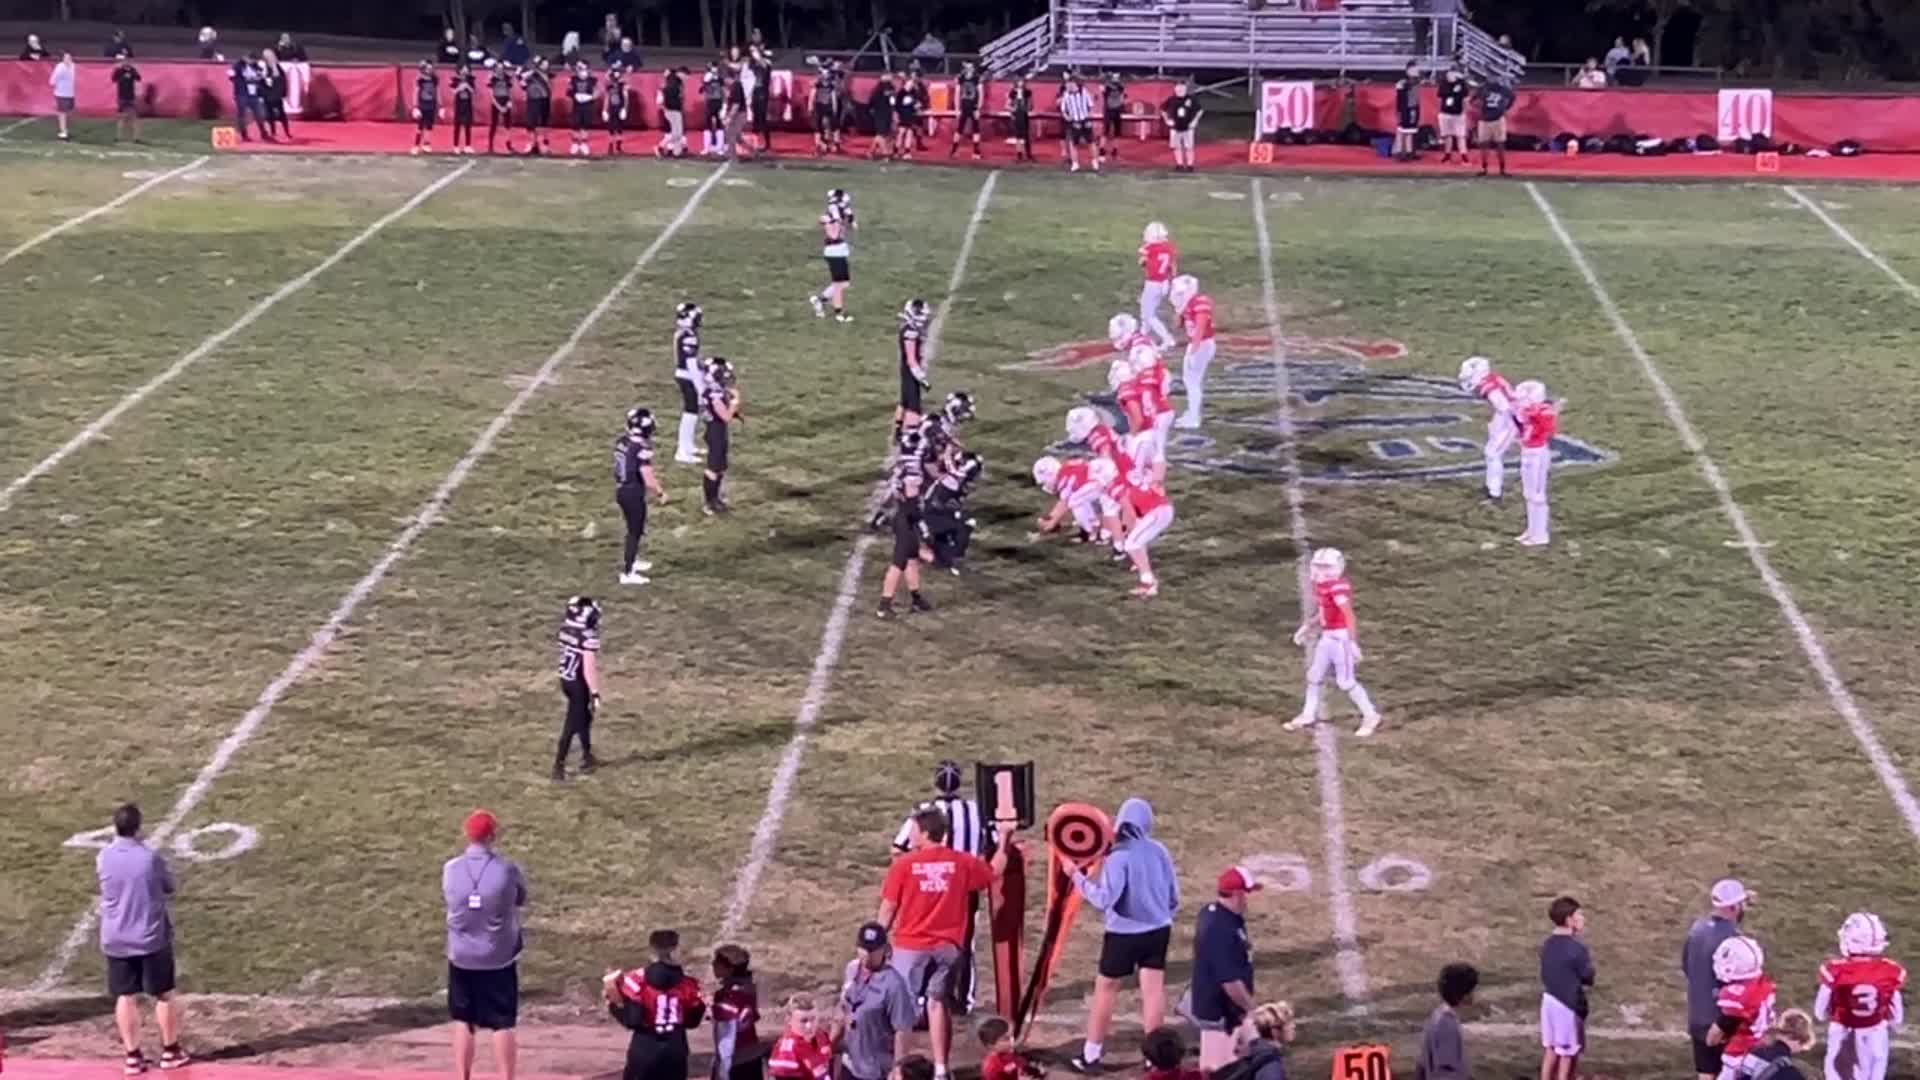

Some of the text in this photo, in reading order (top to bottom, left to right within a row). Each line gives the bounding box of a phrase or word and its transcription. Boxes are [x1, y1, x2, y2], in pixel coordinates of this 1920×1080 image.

[1265, 86, 1309, 130] 50
[1721, 93, 1767, 134] 40
[1157, 253, 1169, 273] 7
[994, 770, 1017, 819] 1
[655, 995, 679, 1025] 11
[1851, 984, 1877, 1017] 3
[1344, 1052, 1386, 1080] 50
